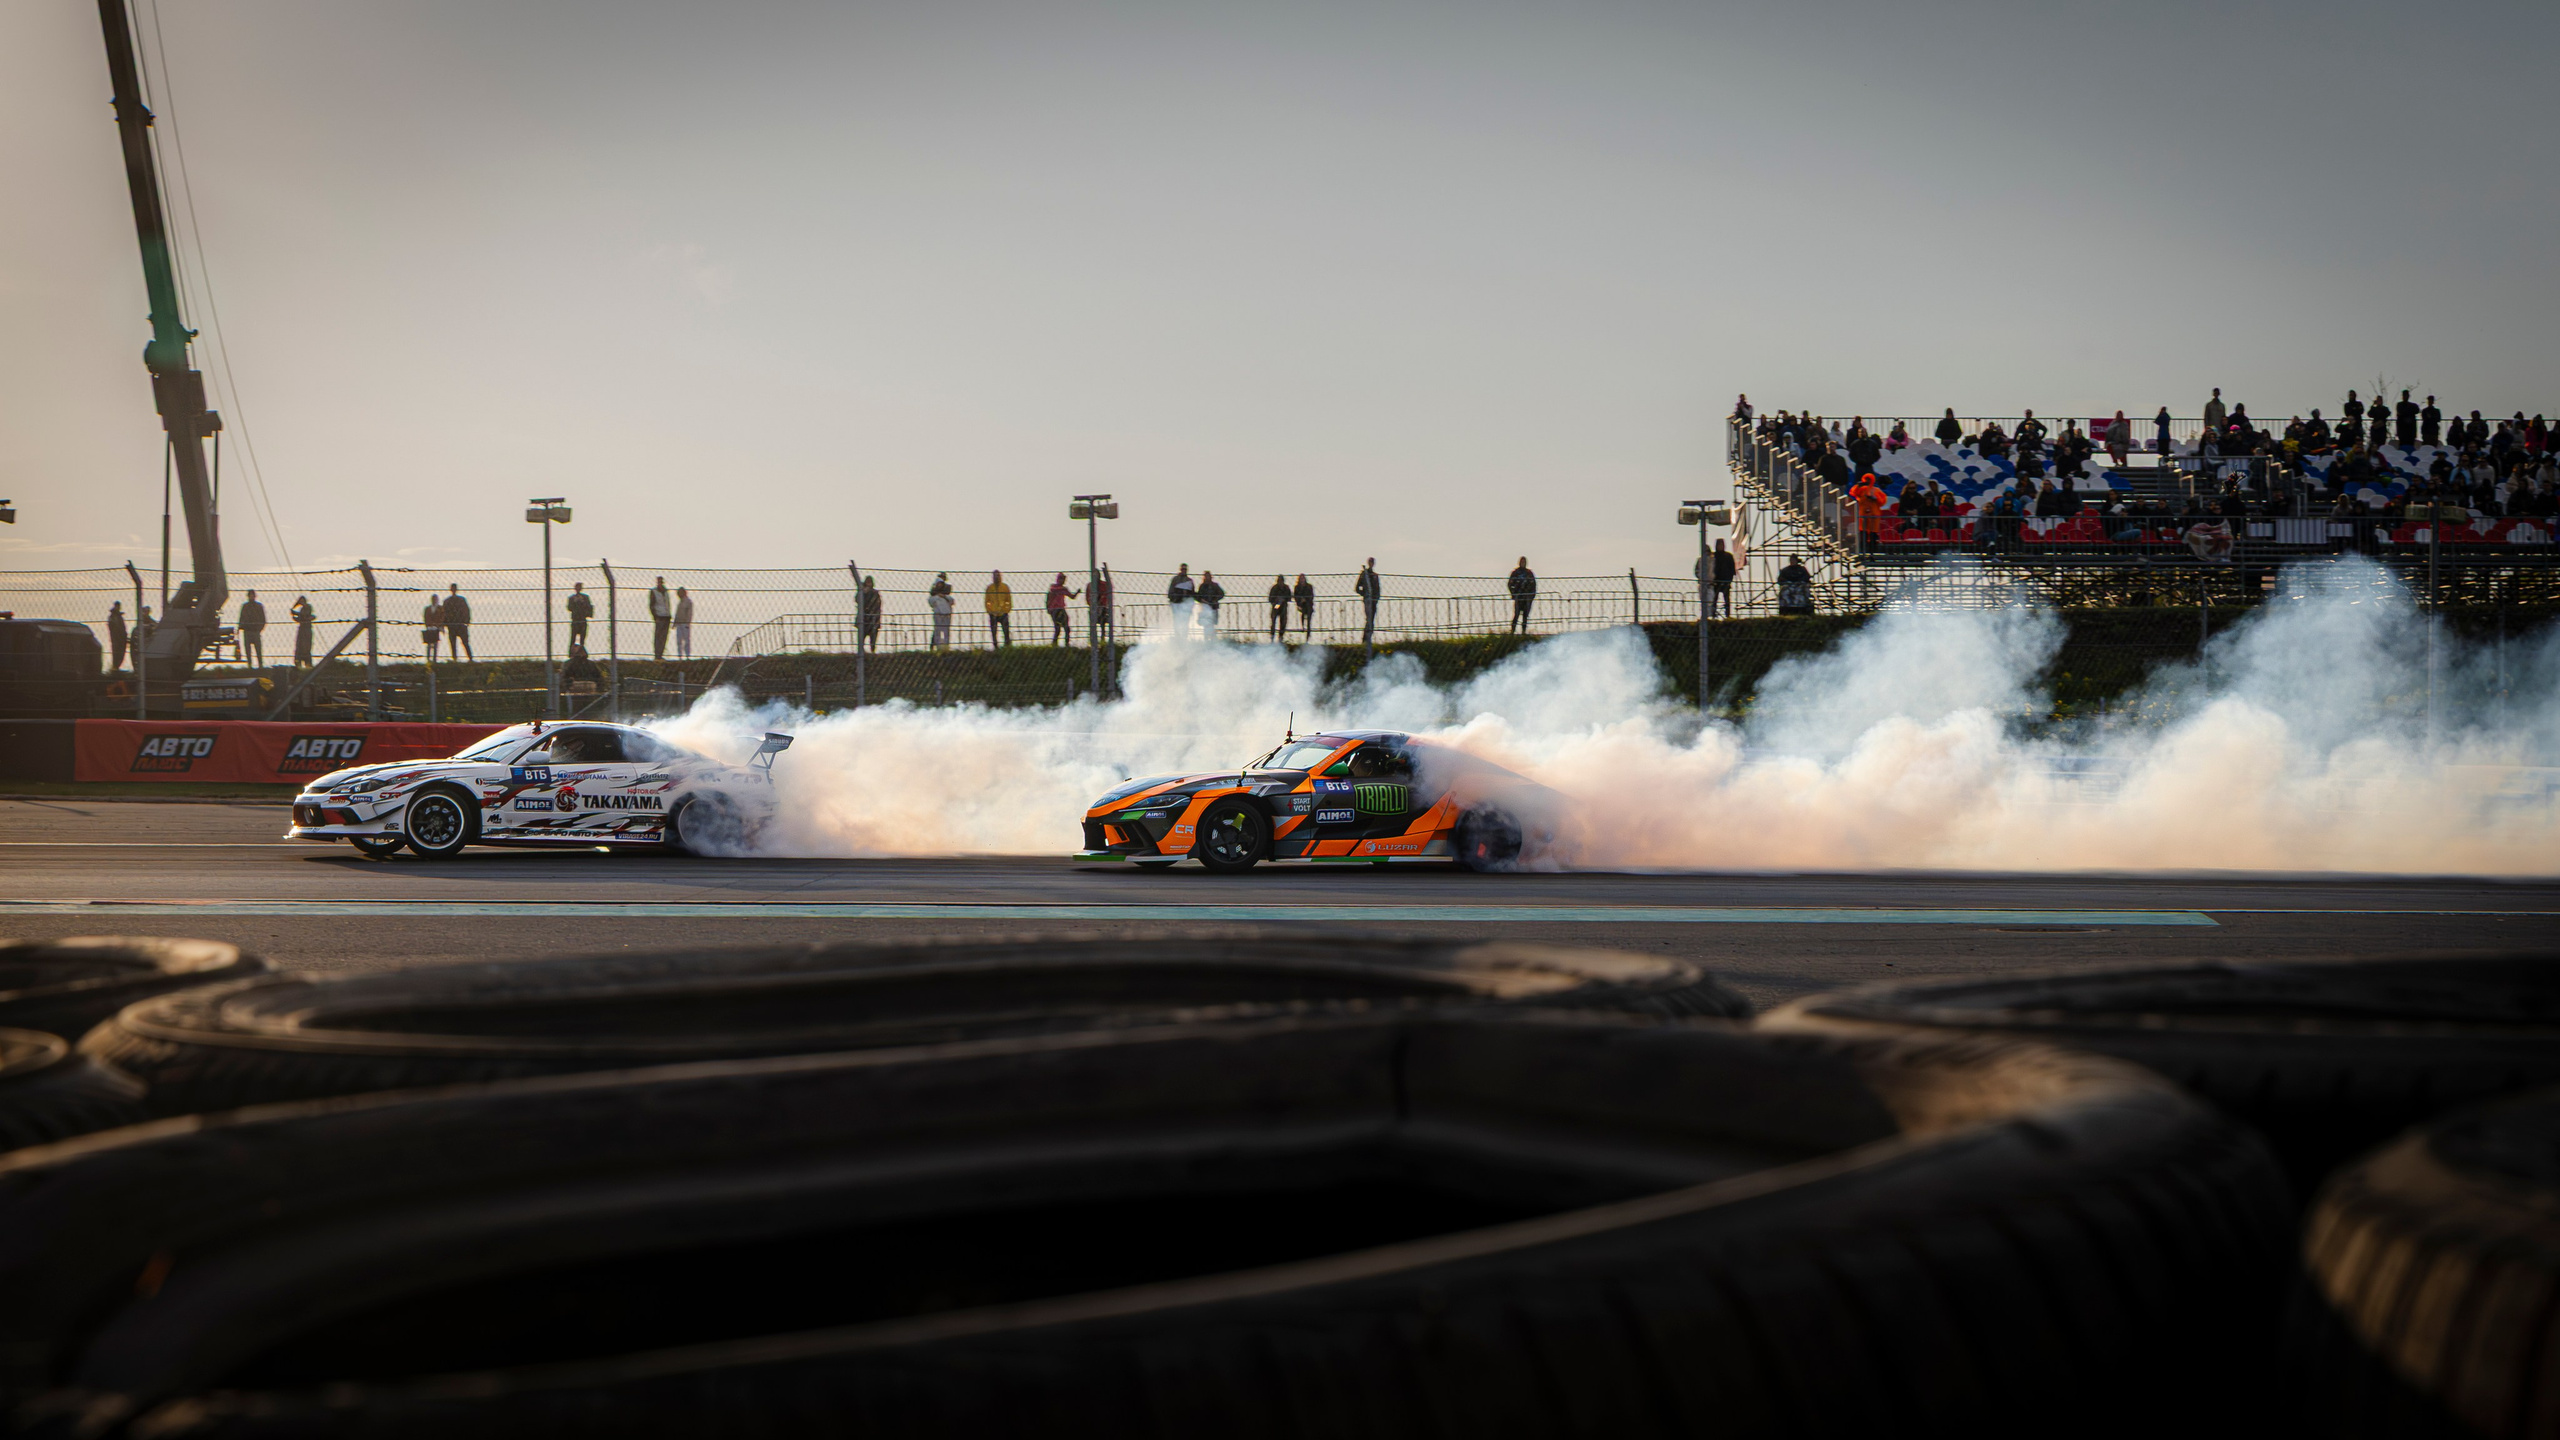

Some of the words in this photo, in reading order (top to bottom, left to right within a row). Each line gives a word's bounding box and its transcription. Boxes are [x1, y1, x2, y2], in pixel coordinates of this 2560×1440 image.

[140, 738, 213, 756] АВТО
[288, 739, 362, 758] АВТО
[283, 760, 334, 772] ПЛЮС
[524, 769, 548, 781] ВТБ
[1326, 781, 1350, 791] ВТБ
[516, 800, 552, 809] AIMOL
[582, 794, 663, 810] TAKAYAMA
[1357, 785, 1405, 812] TRIALLI
[1318, 812, 1353, 821] AIMOL
[1175, 824, 1194, 835] CR
